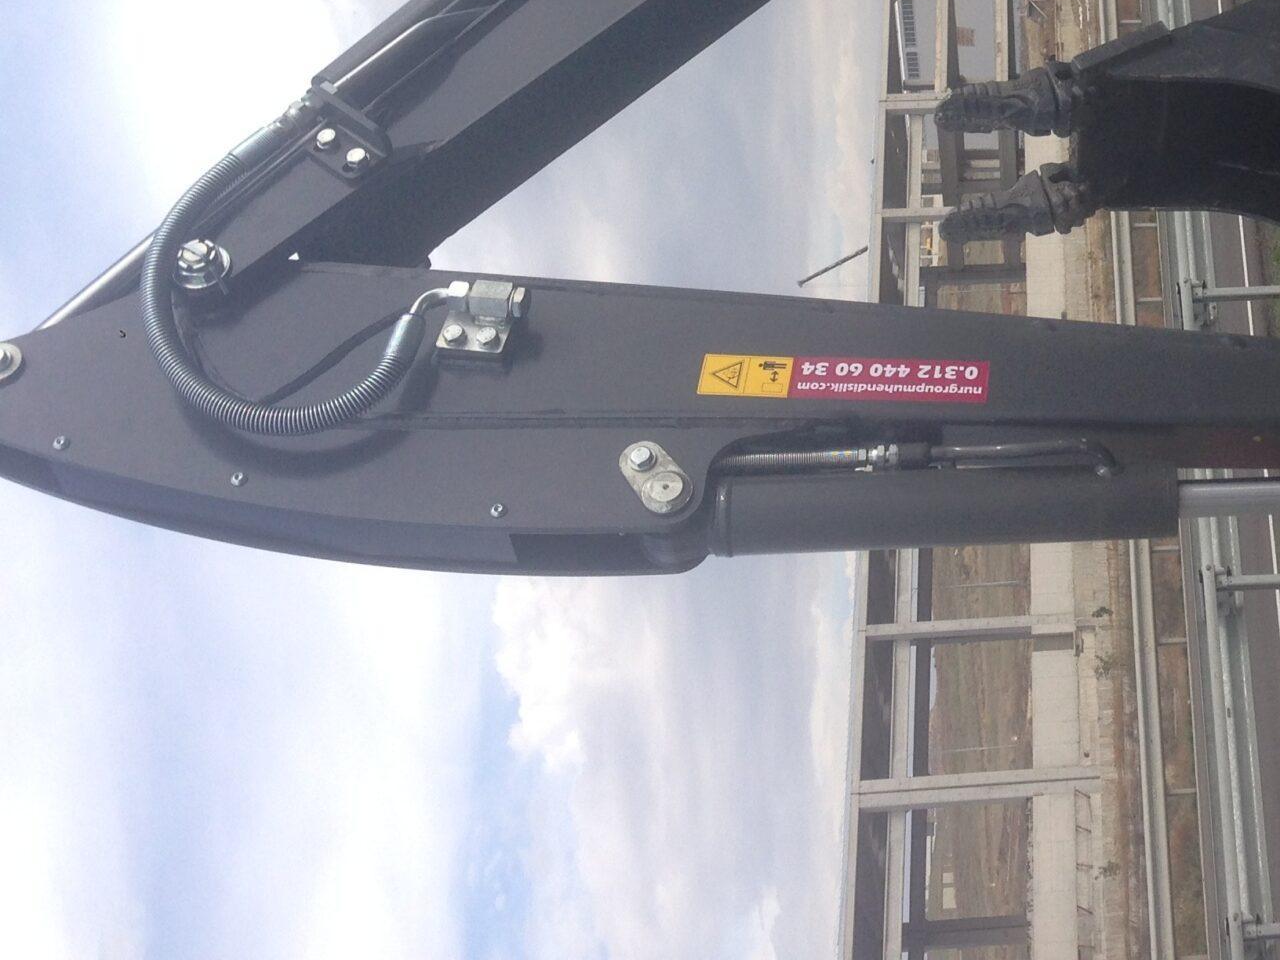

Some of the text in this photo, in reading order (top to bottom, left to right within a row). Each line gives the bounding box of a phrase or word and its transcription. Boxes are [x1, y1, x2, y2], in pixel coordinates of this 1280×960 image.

[801, 361, 979, 380] 0.312 440 60 34
[797, 381, 982, 395] nurgroupmuhendislik.com
